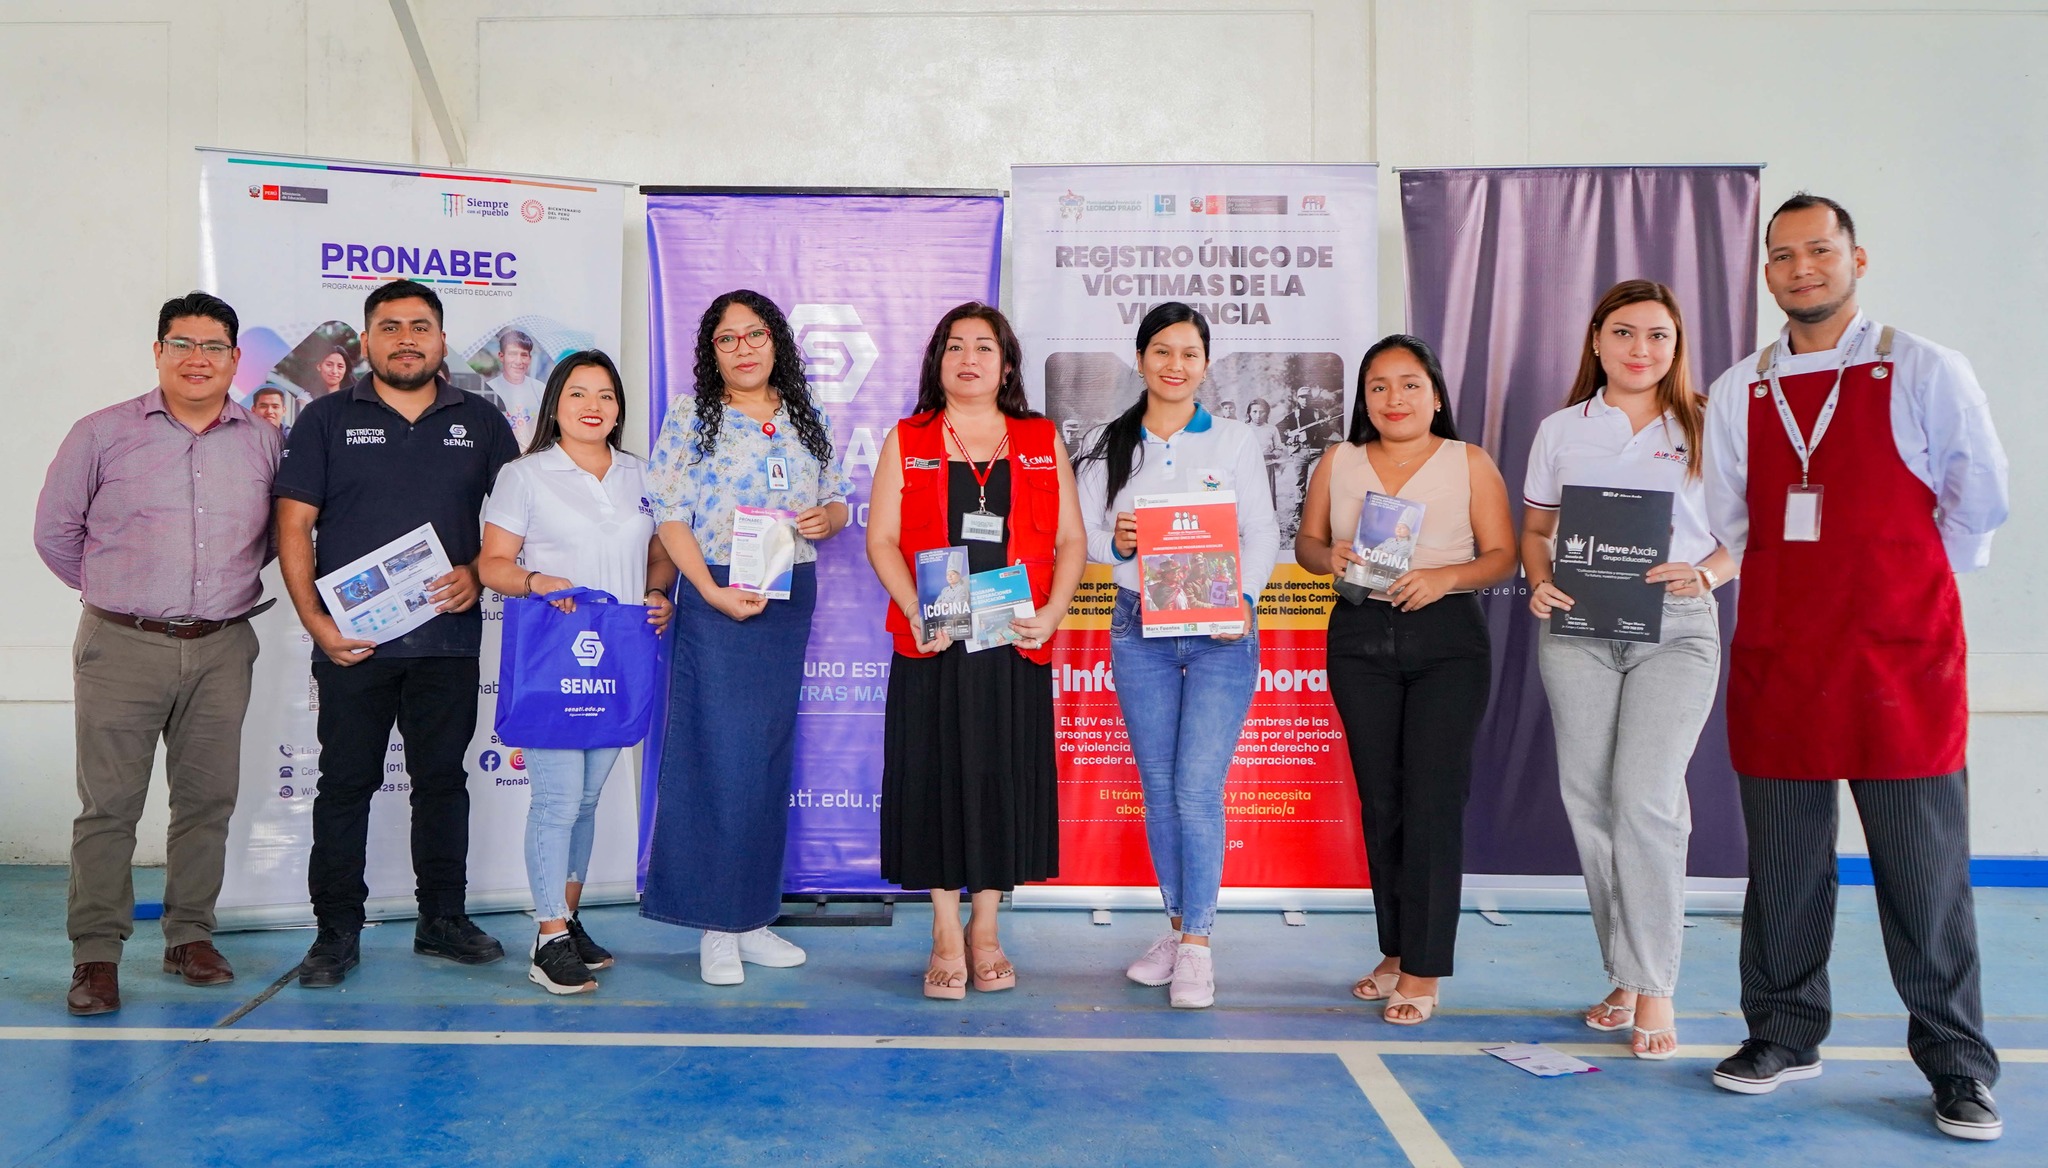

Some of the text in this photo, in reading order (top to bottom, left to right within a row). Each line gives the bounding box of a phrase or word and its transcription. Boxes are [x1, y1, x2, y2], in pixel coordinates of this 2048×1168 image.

[467, 197, 509, 210] Siempre
[548, 206, 581, 214] BICENTENARIO
[481, 208, 509, 217] pueblo
[1055, 237, 1333, 268] REGISTRO ÚNICO DE
[321, 242, 517, 280] PRONABEC
[1081, 267, 1306, 297] VÍCTIMAS DE LA
[322, 282, 364, 291] PROGRAMA
[444, 286, 473, 296] CRÉDITO
[474, 288, 513, 298] EDUCATIVO
[1117, 302, 1272, 325] VINCIA
[346, 428, 385, 437] INSTRUCTOR
[346, 436, 386, 445] PANDURO
[443, 438, 474, 448] SENATI
[1596, 543, 1658, 557] Aleve Axda
[1362, 547, 1409, 571] COCINA
[1602, 554, 1653, 564] Grupo Educativo
[1095, 582, 1118, 593] pers
[1283, 580, 1331, 590] derechos
[1482, 586, 1527, 596] cuela
[1072, 592, 1113, 603] cuencia
[1277, 593, 1291, 603] de
[1292, 593, 1307, 603] los
[1308, 592, 1341, 603] Comit
[927, 600, 971, 619] COCINA
[1067, 606, 1080, 615] de
[1256, 605, 1278, 615] licía
[1279, 605, 1327, 615] Nacional.
[804, 662, 890, 678] URO EST
[1255, 662, 1328, 692] hora
[560, 678, 616, 694] SENATI
[799, 685, 848, 702] TRAS
[564, 705, 606, 713] senati.edu.pe
[1060, 716, 1073, 726] EL
[1074, 716, 1098, 726] RUV
[1099, 718, 1114, 726] es
[1294, 716, 1310, 727] de
[1311, 716, 1330, 727] las
[1055, 730, 1103, 739] ersonas
[1104, 731, 1112, 742] y
[1261, 731, 1282, 742] por
[1283, 729, 1295, 739] el
[1296, 729, 1343, 742] periodo
[1060, 742, 1075, 752] de
[1077, 742, 1131, 752] violencia
[1269, 742, 1320, 752] derecho
[1321, 744, 1330, 752] a
[386, 762, 404, 773] (01)
[1073, 755, 1123, 765] acceder
[1231, 754, 1317, 768] Reparaciones.
[495, 776, 530, 786] Pronab
[1100, 789, 1312, 803] El trám y no necesita
[1116, 802, 1295, 818] abog rmediario/a
